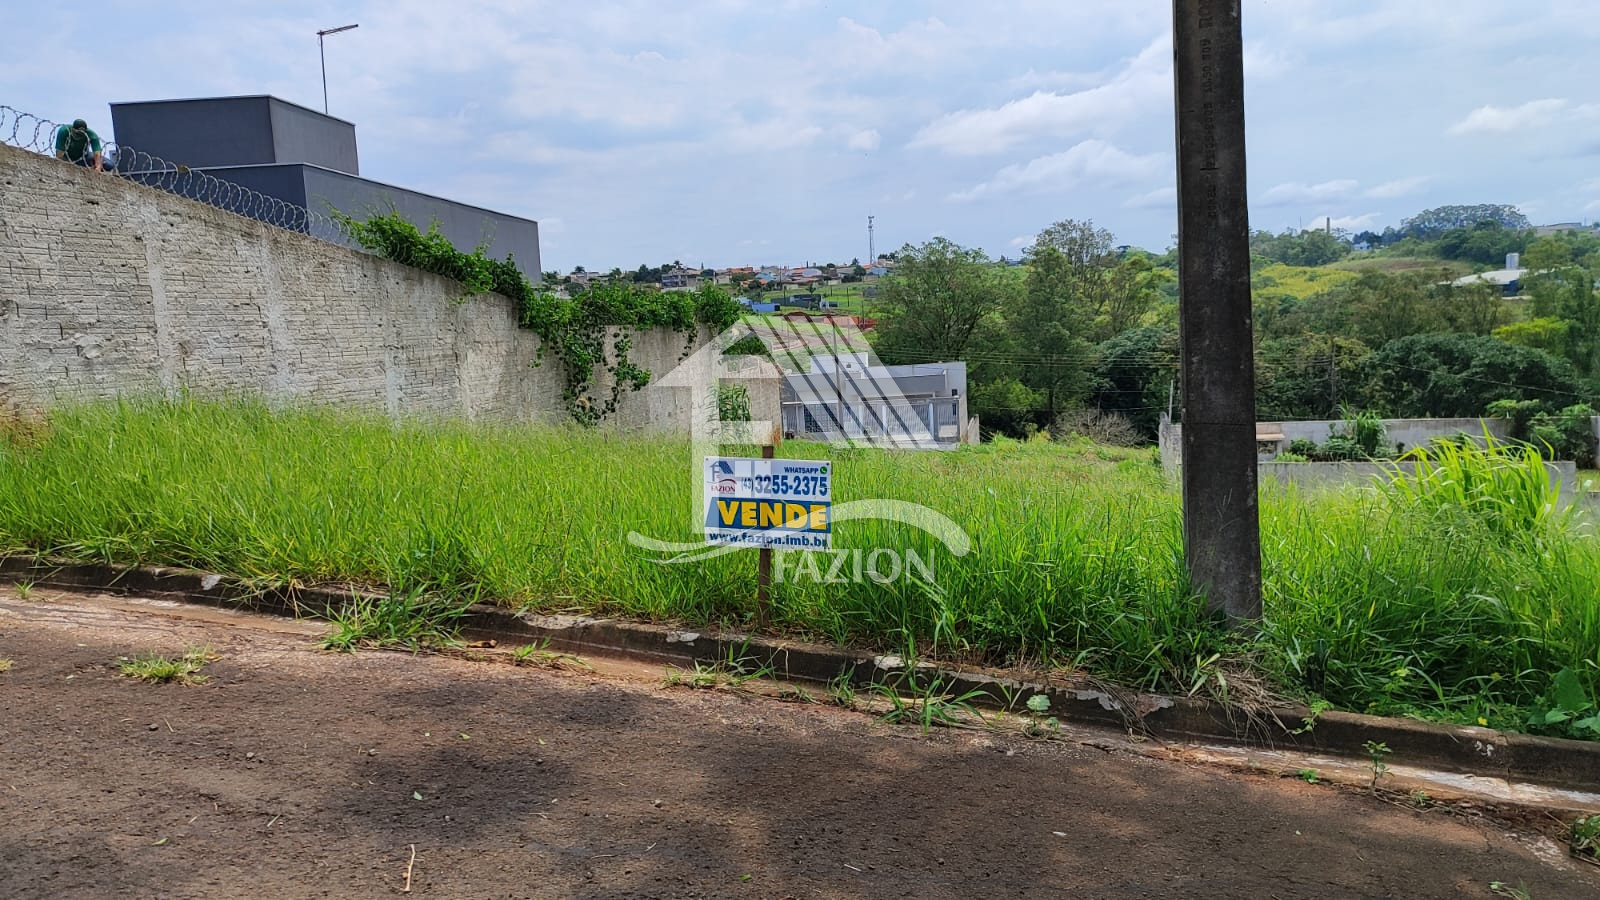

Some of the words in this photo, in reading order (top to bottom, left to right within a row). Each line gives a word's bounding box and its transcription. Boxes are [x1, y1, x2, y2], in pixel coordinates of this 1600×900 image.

[783, 466, 819, 474] WHATSAPP
[711, 485, 736, 493] FAZION
[755, 474, 828, 497] 3255-2375
[716, 500, 827, 530] VENDE
[709, 532, 828, 547] www.fazion.imb.br
